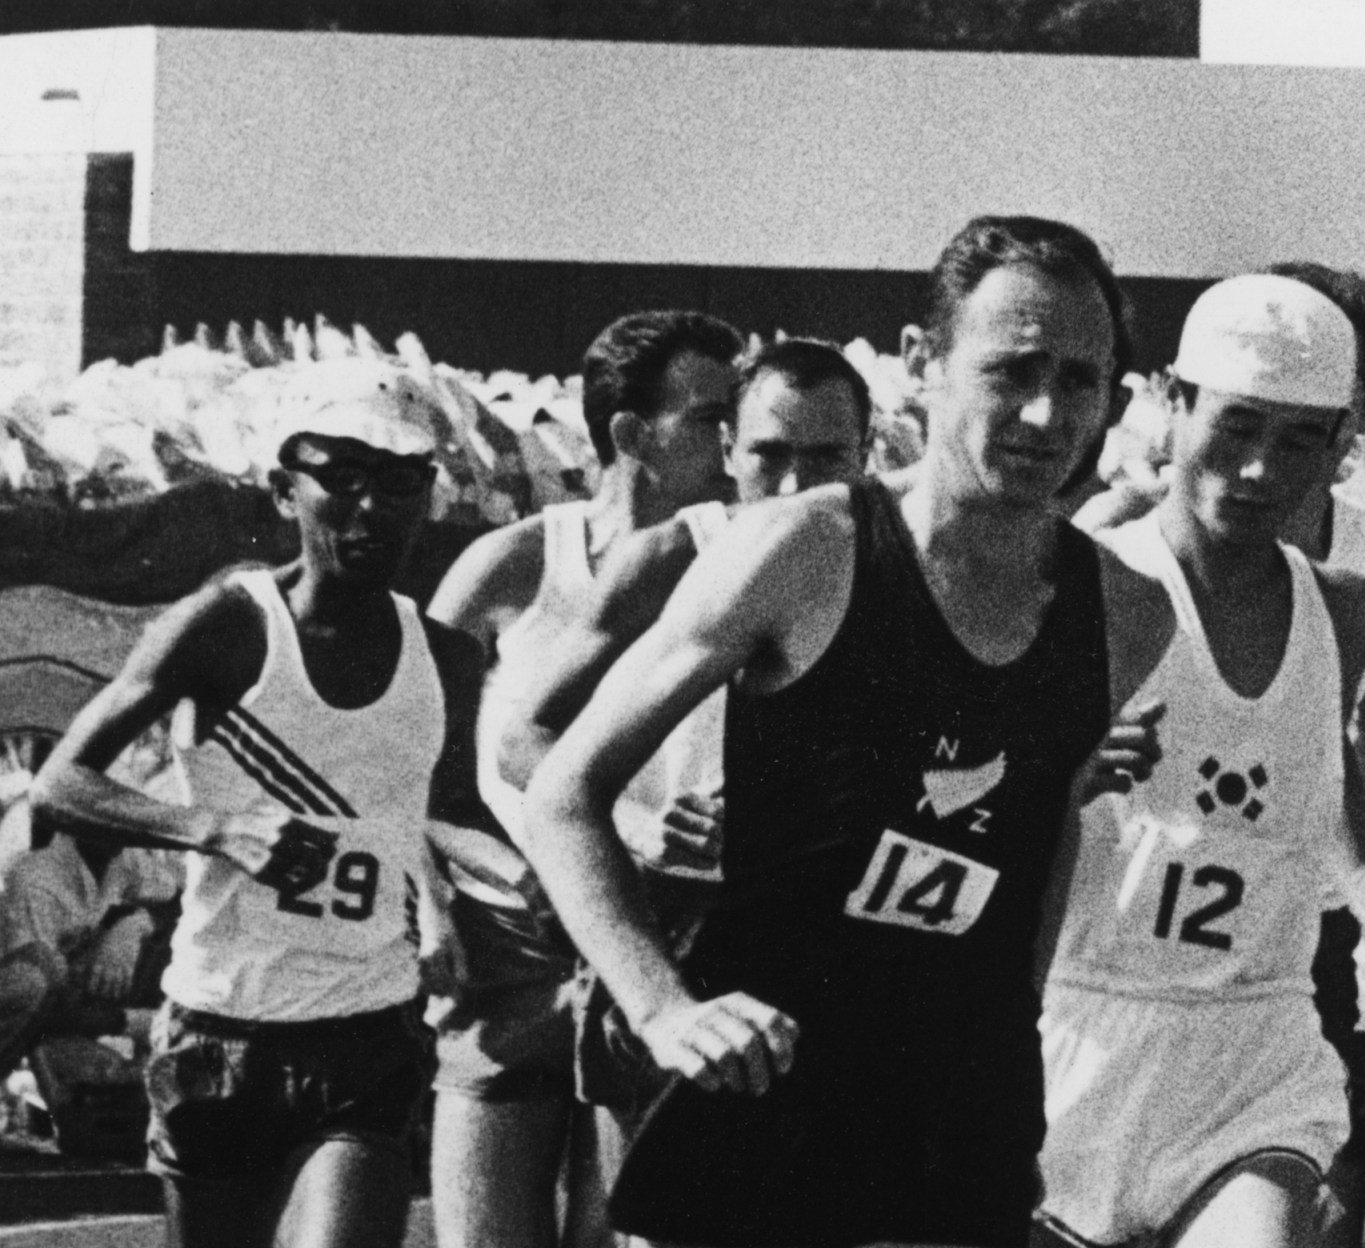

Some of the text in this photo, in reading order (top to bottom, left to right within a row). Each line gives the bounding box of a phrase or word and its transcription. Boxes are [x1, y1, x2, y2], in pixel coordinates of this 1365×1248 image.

[935, 735, 960, 761] N
[968, 807, 992, 834] Z
[862, 843, 969, 926] 14
[1154, 861, 1245, 950] 12
